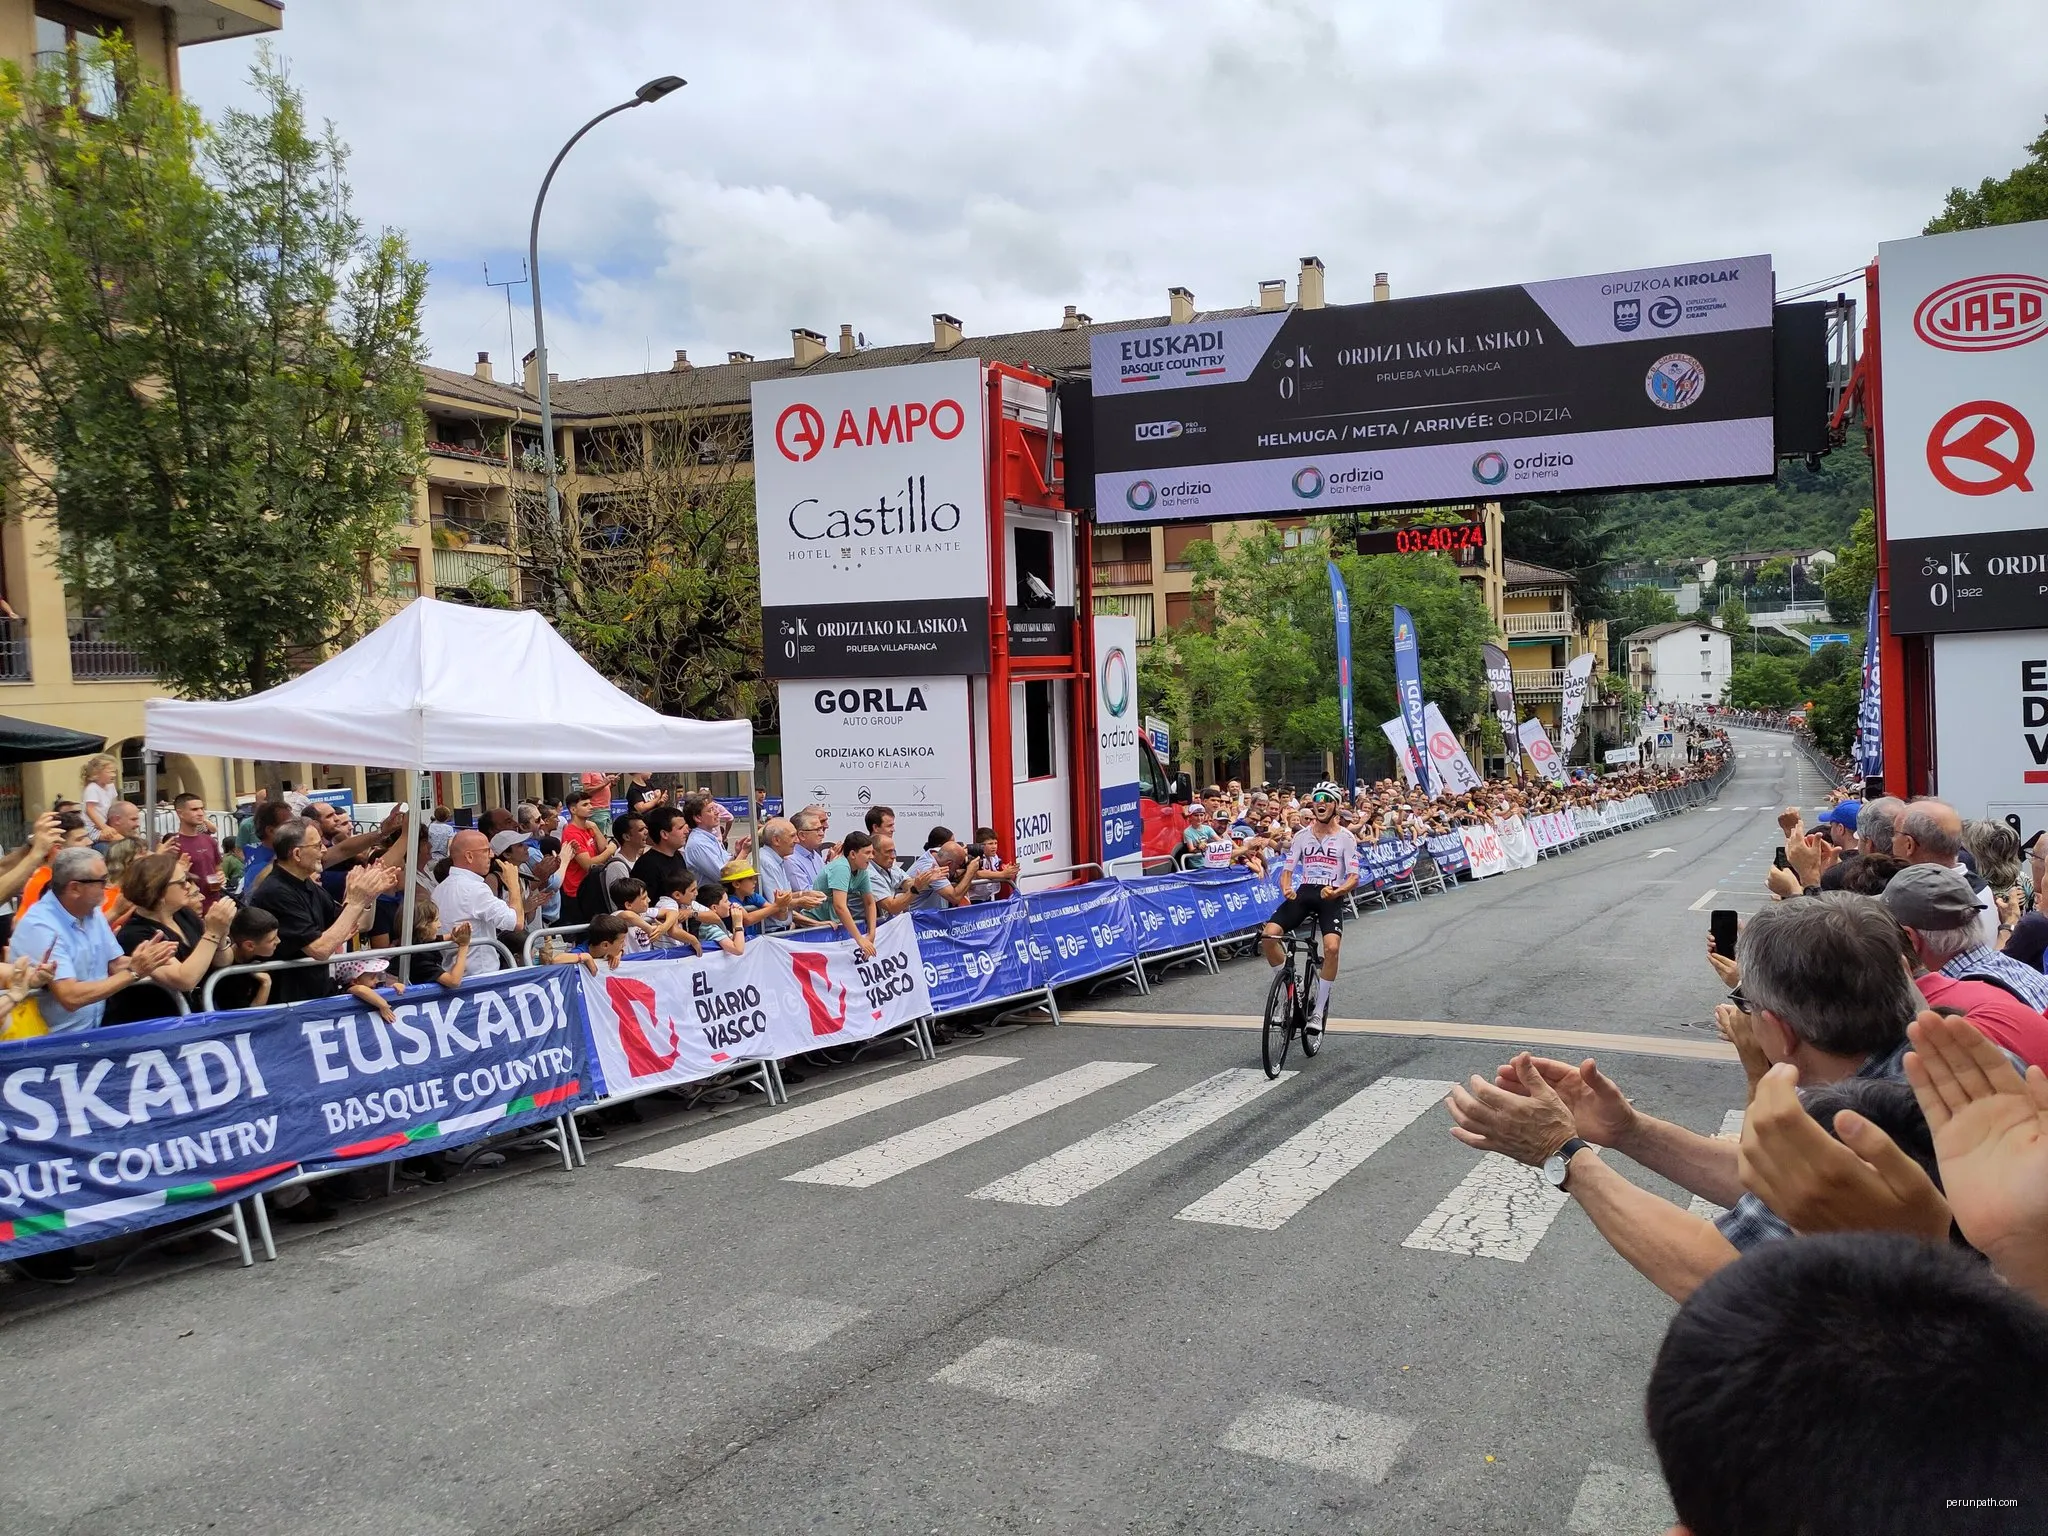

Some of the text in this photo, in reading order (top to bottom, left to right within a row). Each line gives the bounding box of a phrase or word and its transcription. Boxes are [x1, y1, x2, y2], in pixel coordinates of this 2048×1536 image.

[1601, 269, 1740, 295] GIPUZKOA KIROLAK
[1120, 330, 1224, 361] EUSKADI
[1337, 328, 1545, 367] ORDIZIAKO KLASIKOA
[1120, 354, 1225, 376] BASQUE COUNTRY
[1377, 361, 1501, 383] PRUEBA VILLAFRANCA
[833, 398, 965, 449] AMPO
[1138, 425, 1164, 438] UCI
[1258, 406, 1573, 447] HELMUGA / META / ARRIVÉE: ORDIZIA
[1513, 451, 1574, 470] ordizia
[1329, 467, 1384, 484] ordizia
[1161, 480, 1212, 497] ordizia
[1396, 525, 1484, 553] 03:40:24
[788, 541, 961, 561] HOTEL RESTAURANTE
[1952, 552, 1972, 576] K
[1987, 554, 2048, 576] ORDI
[1957, 587, 1984, 598] 1922
[798, 618, 809, 636] K
[817, 617, 968, 637] ORDIZIAKO KLASIKOA
[846, 642, 938, 653] PRUEBA VILLAFRANCA
[814, 687, 928, 714] GORLA
[843, 716, 904, 726] AUTO GROUP
[1101, 725, 1135, 749] ordizia
[815, 747, 935, 758] ORDIZIAKO KLASIKOA
[839, 760, 911, 769] AUTO OFIZIALA
[1016, 812, 1052, 840] SKADI
[1023, 839, 1054, 857] COUNTRY
[1209, 843, 1231, 853] UAE
[1304, 846, 1338, 858] UAE
[692, 970, 713, 997] EL
[695, 984, 761, 1024] DIARIO
[301, 977, 568, 1084] EUSKADI
[703, 1009, 767, 1049] VASCO
[0, 1032, 269, 1142] SKADI
[320, 1044, 573, 1135] BASQUE COUNTRY
[88, 1114, 279, 1186] COUNTRY
